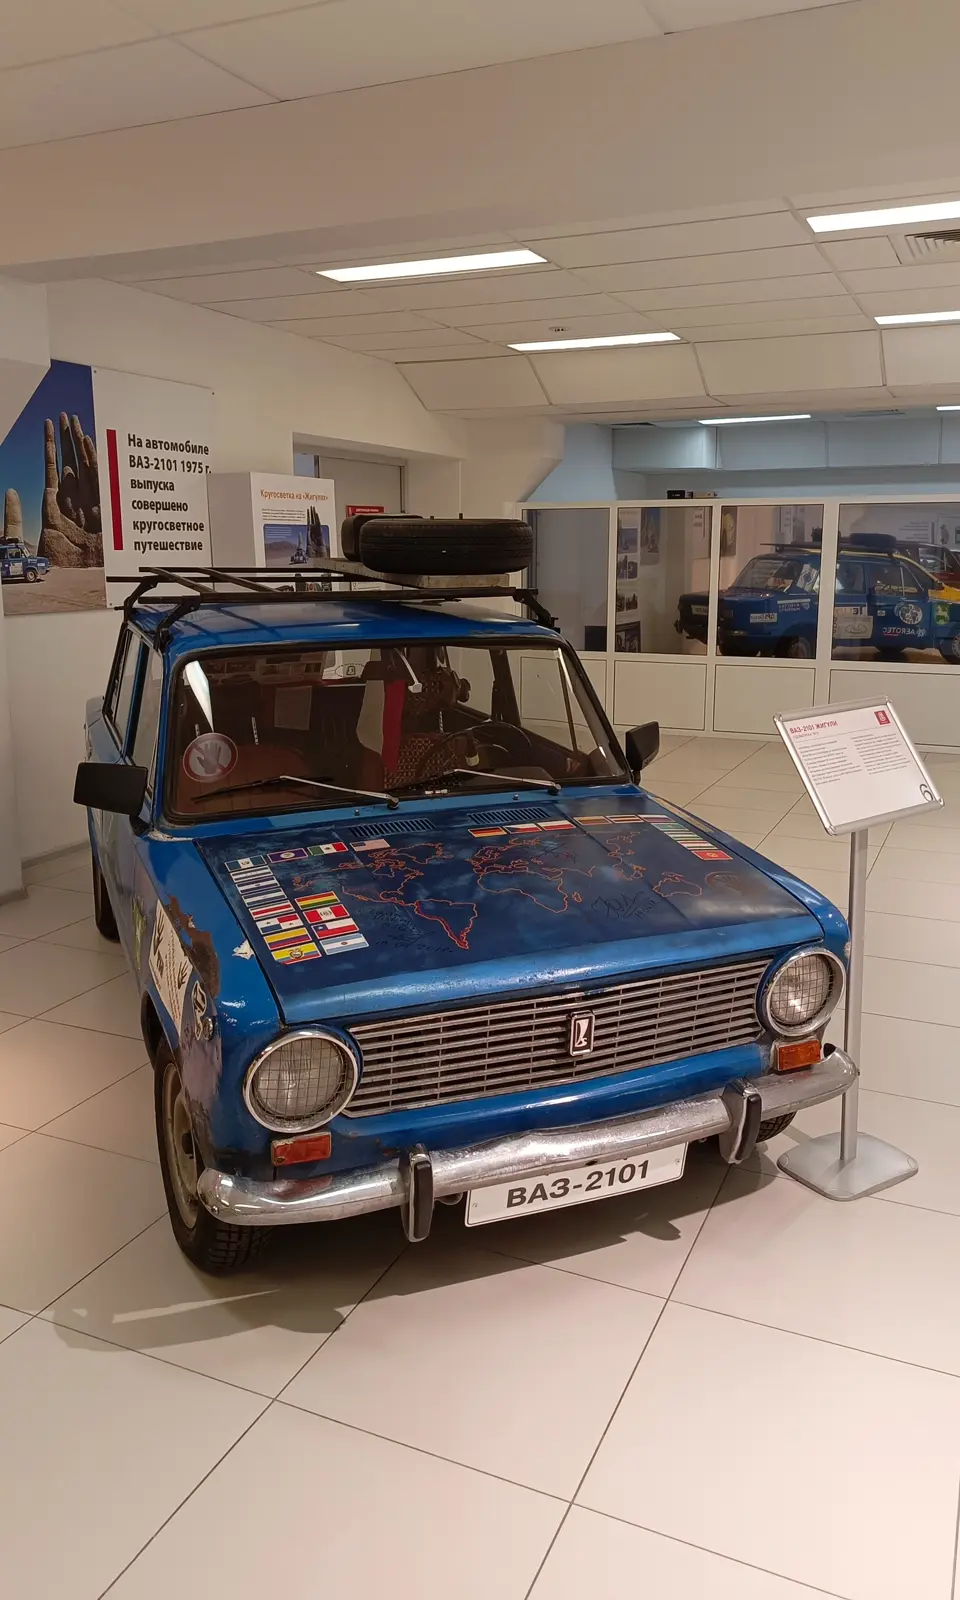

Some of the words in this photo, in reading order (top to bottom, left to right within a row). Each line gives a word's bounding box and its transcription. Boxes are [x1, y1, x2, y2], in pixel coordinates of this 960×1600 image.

[127, 431, 143, 449] На
[145, 438, 210, 456] автомобиле
[128, 454, 178, 472] ВАЗ-2101
[180, 460, 204, 474] 1975
[205, 465, 212, 474] г.
[130, 478, 175, 494] выпуска
[260, 489, 295, 500] Кругосветка
[131, 499, 189, 514] совершено
[132, 520, 205, 535] кругосветное
[133, 540, 203, 555] путешествие
[789, 724, 815, 734] ВАЗ-2101
[815, 721, 838, 730] ЖИГУЛИ
[505, 1160, 650, 1208] ВАЗ-2101
